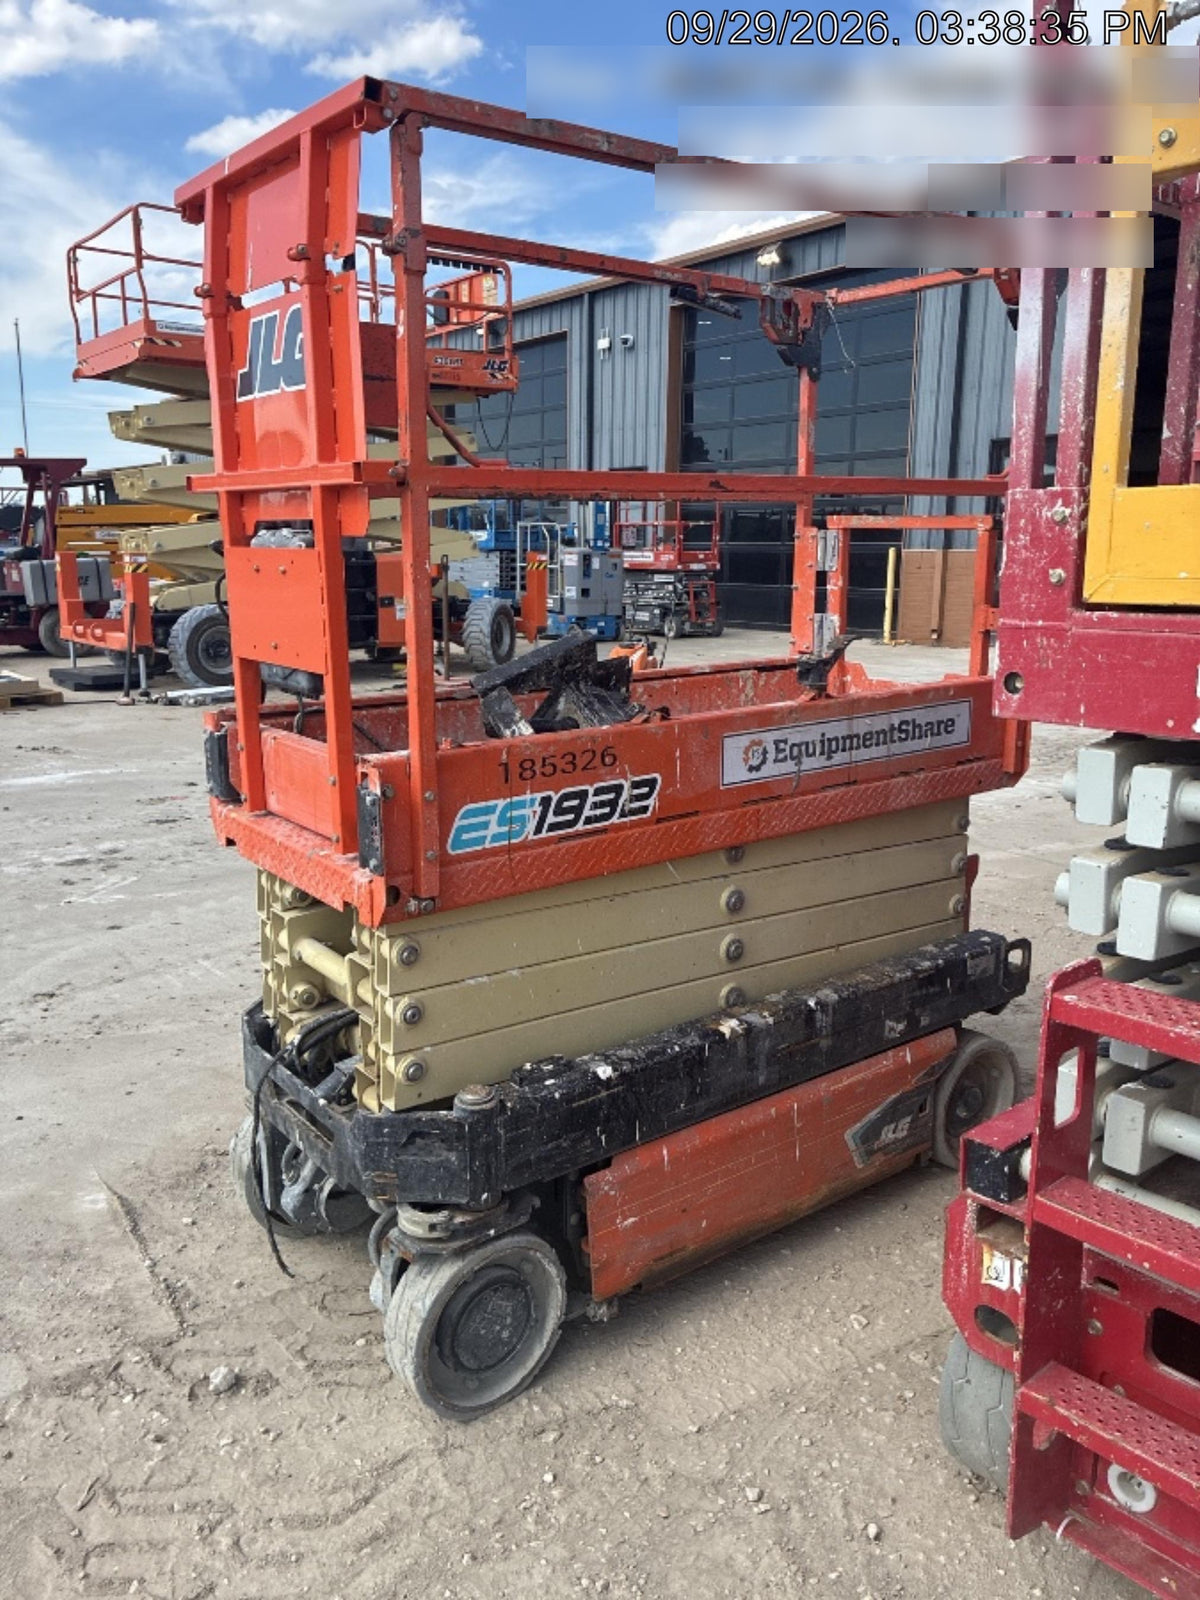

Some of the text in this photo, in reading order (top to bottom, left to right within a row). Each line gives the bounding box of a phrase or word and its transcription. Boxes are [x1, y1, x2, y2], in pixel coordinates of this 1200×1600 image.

[482, 357, 510, 372] JLG
[773, 717, 956, 768] EquipmentShare
[498, 746, 617, 784] 185326
[447, 773, 662, 854] ES1932
